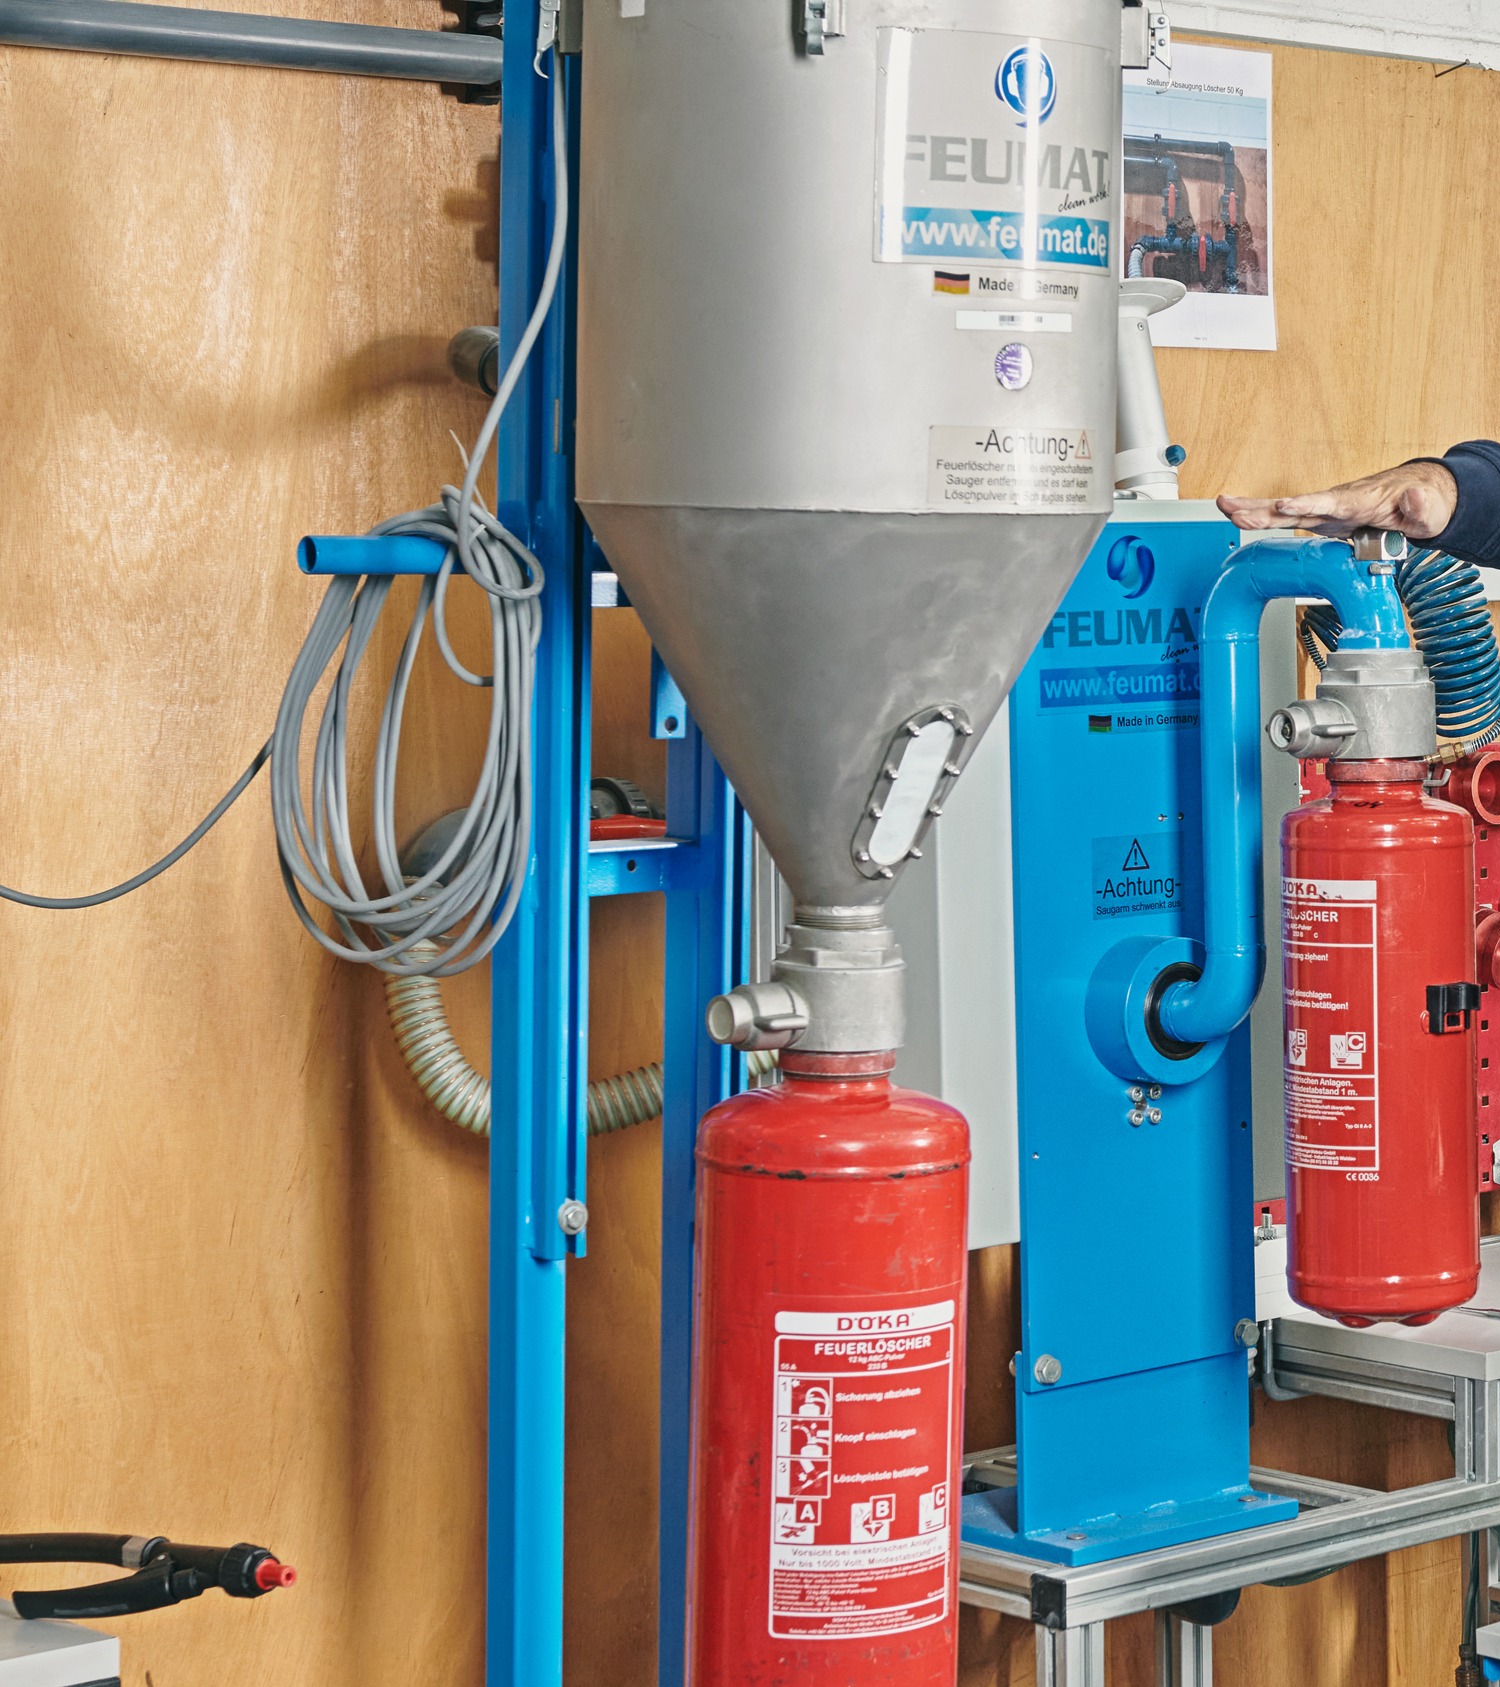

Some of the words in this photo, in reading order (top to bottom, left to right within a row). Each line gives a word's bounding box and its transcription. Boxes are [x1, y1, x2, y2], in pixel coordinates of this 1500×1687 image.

[1171, 80, 1202, 92] Absaugung
[1203, 83, 1226, 93] Löscher
[1227, 86, 1234, 94] 50
[1235, 87, 1244, 96] Kg
[904, 133, 1109, 194] FEUMAT
[1058, 192, 1086, 212] clean
[978, 276, 1014, 292] Made
[936, 459, 1004, 472] Feuerlöscher
[946, 474, 984, 488] Sauger
[1051, 480, 1060, 488] es
[944, 489, 1007, 502] Löschpulver
[1043, 607, 1201, 649] FEUMA
[1160, 645, 1190, 662] clean
[1117, 716, 1142, 727] Made
[1145, 714, 1154, 726] in
[1156, 713, 1199, 725] Germany
[1096, 876, 1181, 899] -Achtung-
[1096, 905, 1130, 917] Saugarm
[1131, 901, 1166, 912] schwenkt
[1297, 1031, 1306, 1046] B
[1348, 1034, 1364, 1050] C
[1320, 1078, 1354, 1088] Anlagen.
[1357, 1172, 1379, 1182] 0036
[814, 1334, 932, 1356] FEUERLÖSCHER
[781, 1381, 788, 1392] 1
[835, 1391, 883, 1402] Sicherung
[780, 1421, 788, 1432] 2
[834, 1432, 864, 1443] Knopf
[865, 1427, 917, 1442] einschlagen
[779, 1462, 787, 1473] 3
[833, 1471, 892, 1484] Löschpistole
[800, 1503, 816, 1521] A
[875, 1500, 890, 1517] B
[935, 1488, 945, 1506] C
[791, 1547, 832, 1557] Vorsicht
[834, 1547, 850, 1556] bei
[853, 1543, 908, 1556] elektrischen
[778, 1558, 795, 1567] Nur
[798, 1558, 813, 1568] bis
[816, 1557, 840, 1568] 1000
